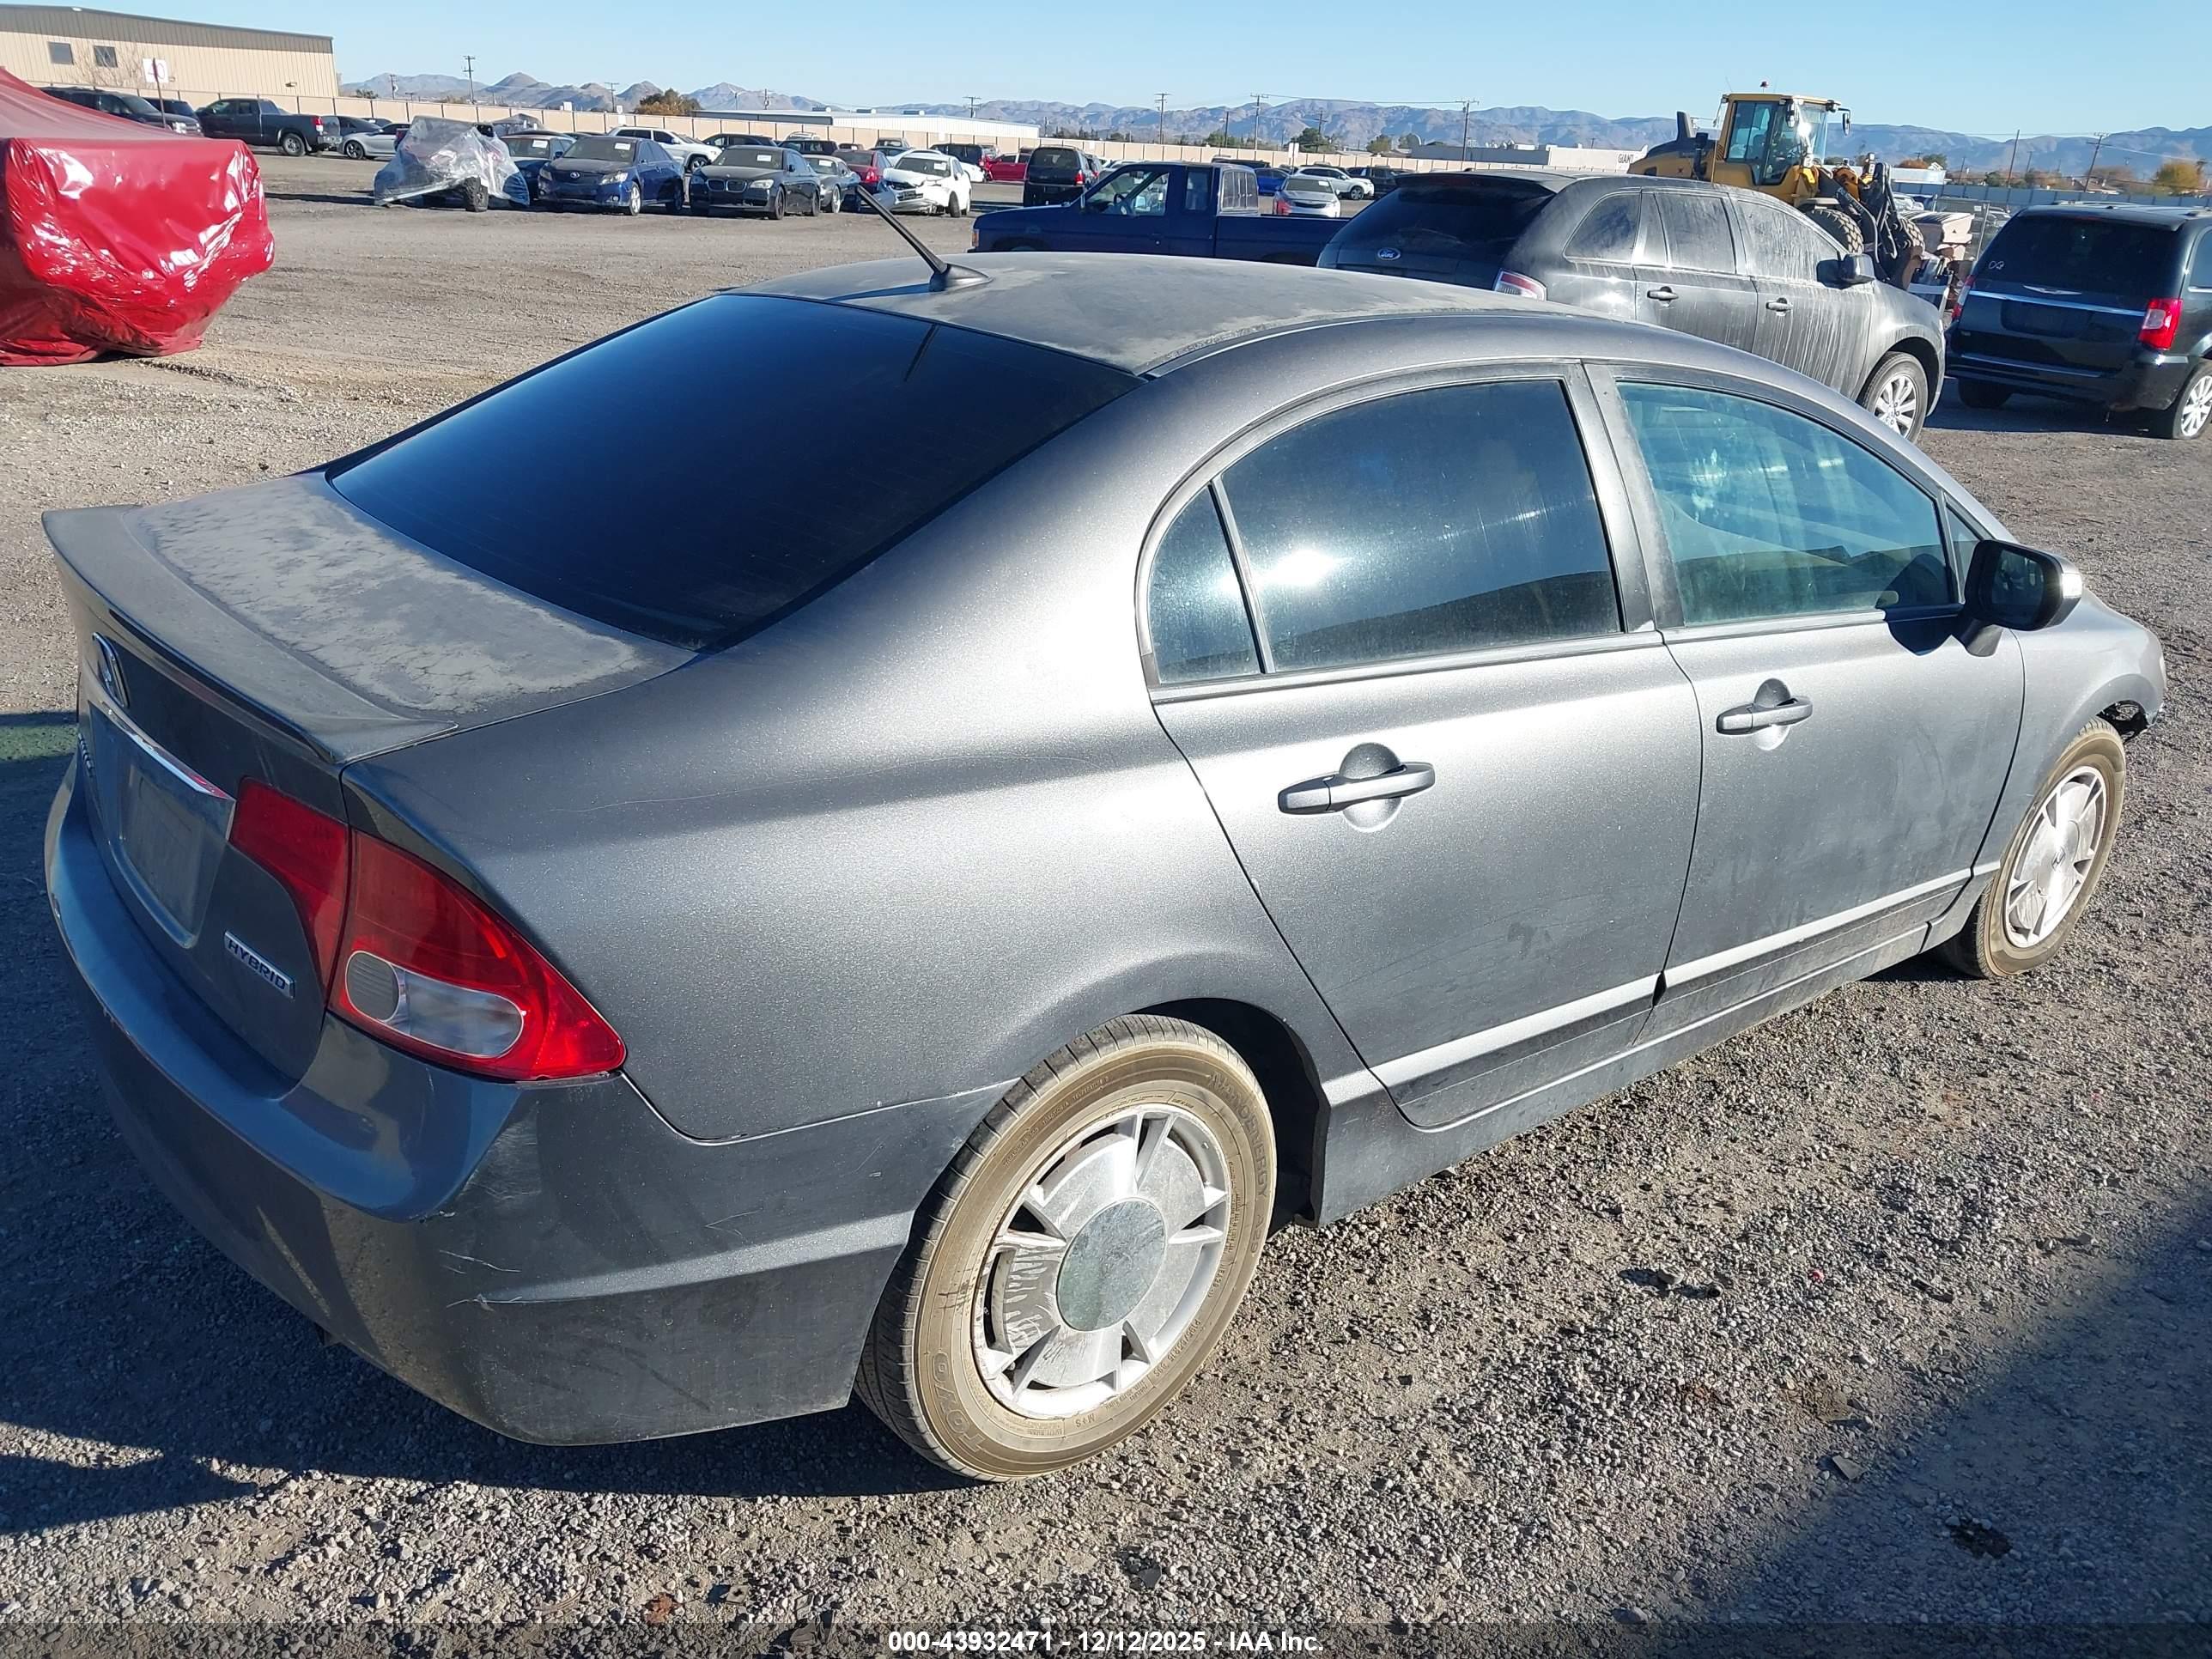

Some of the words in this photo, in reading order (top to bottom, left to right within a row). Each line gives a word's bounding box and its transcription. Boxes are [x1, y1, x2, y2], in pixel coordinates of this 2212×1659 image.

[1618, 153, 1634, 163] GIANT
[1379, 248, 1397, 258] Ford
[228, 939, 286, 990] HYBRID
[932, 1351, 985, 1453] TOYO
